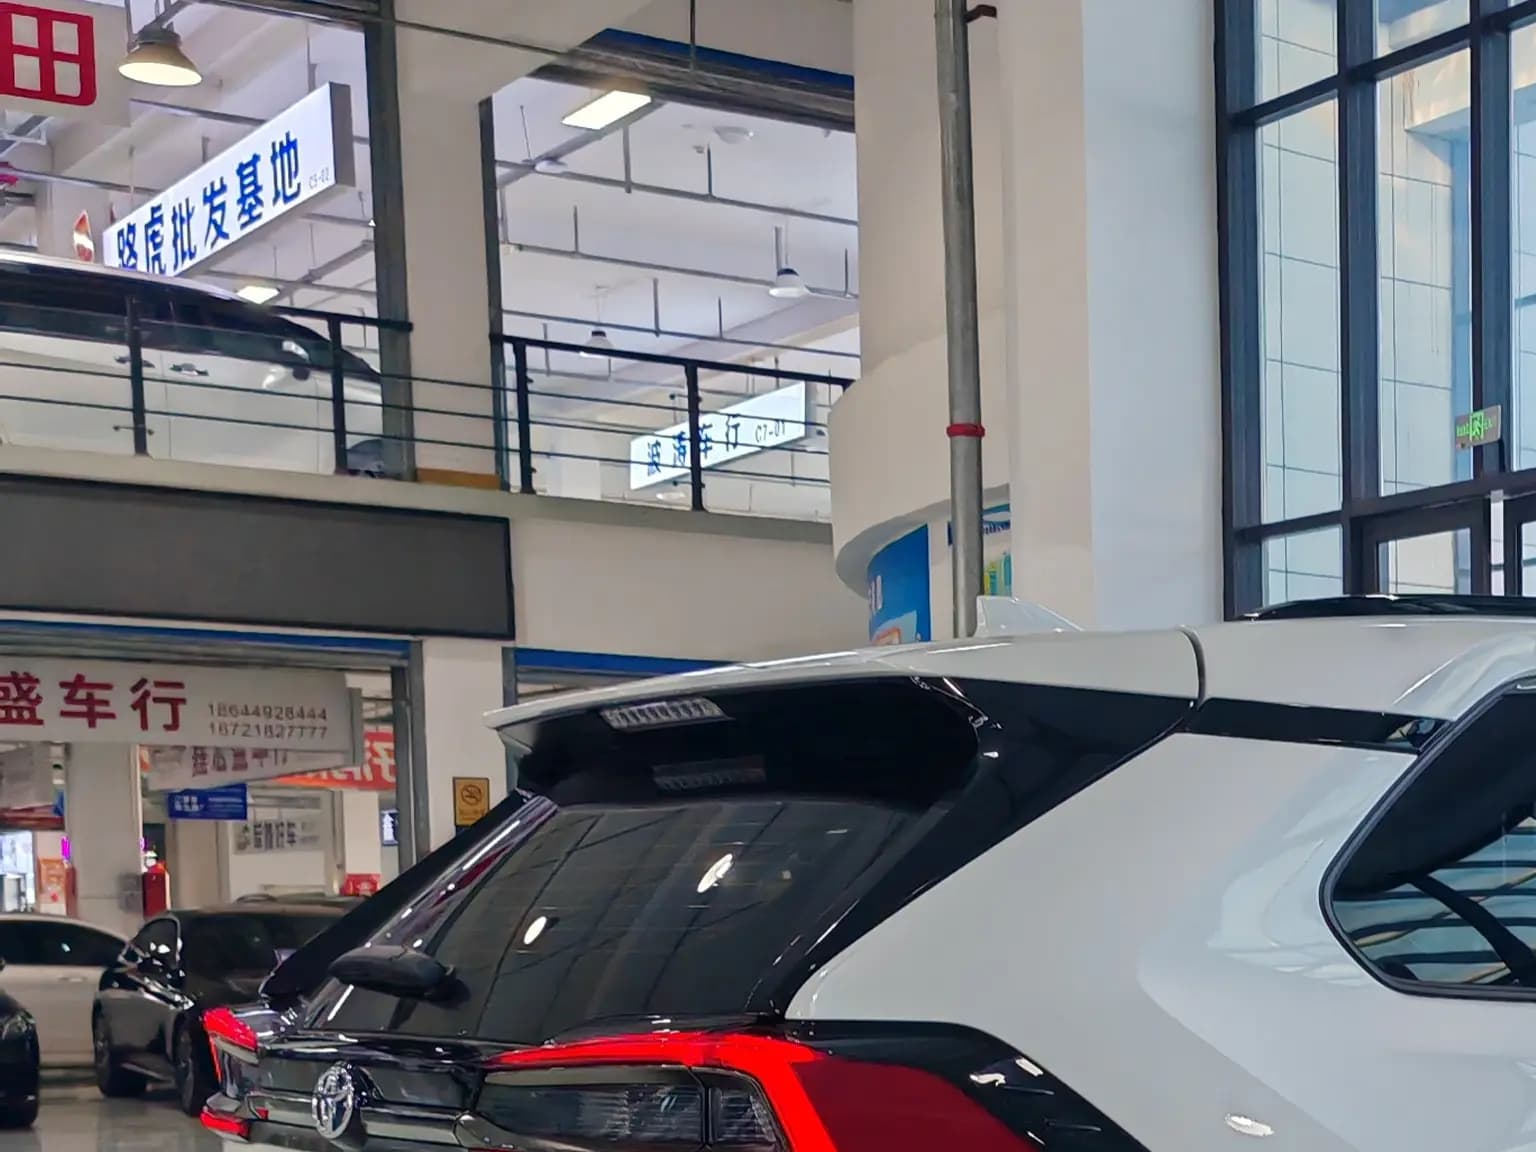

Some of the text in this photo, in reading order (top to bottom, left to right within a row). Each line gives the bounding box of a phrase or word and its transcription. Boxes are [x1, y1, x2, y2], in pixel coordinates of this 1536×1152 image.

[116, 131, 302, 275] 路虎批发基地
[0, 671, 187, 732] 盛车行
